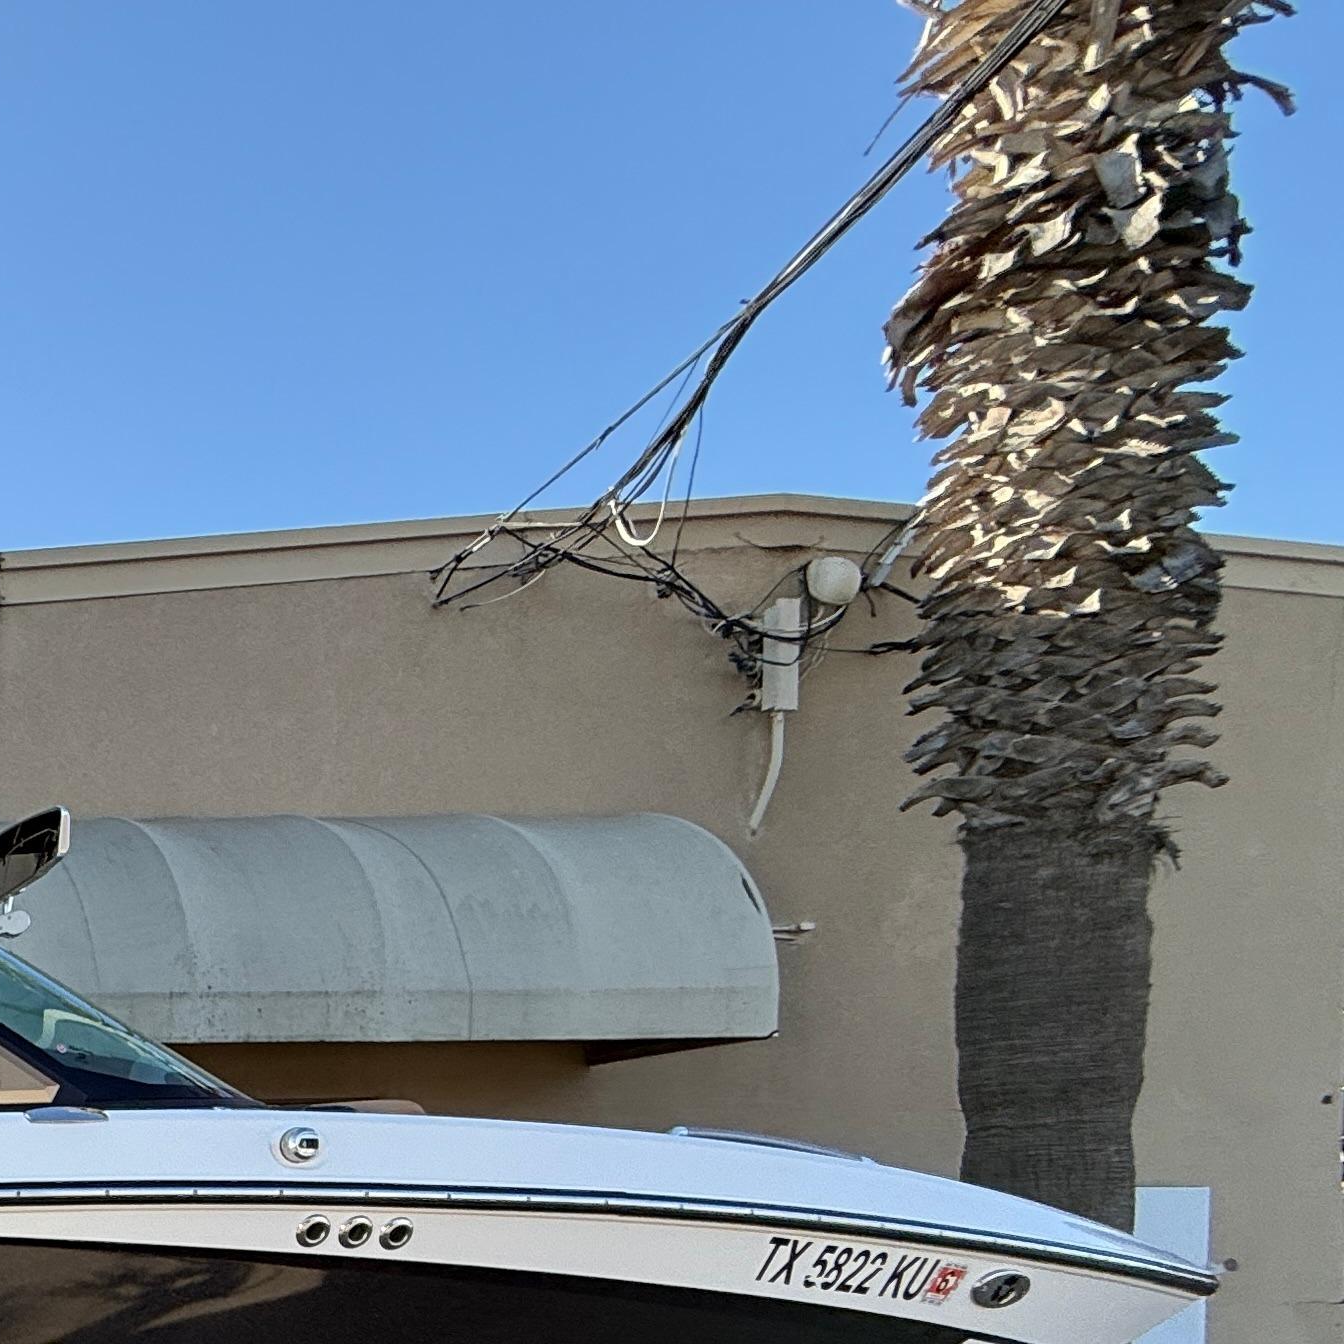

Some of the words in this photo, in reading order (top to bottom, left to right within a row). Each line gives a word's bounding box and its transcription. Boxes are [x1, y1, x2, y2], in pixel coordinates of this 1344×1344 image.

[755, 1236, 813, 1286] TX
[803, 1245, 889, 1295] 5822
[878, 1254, 942, 1301] KU
